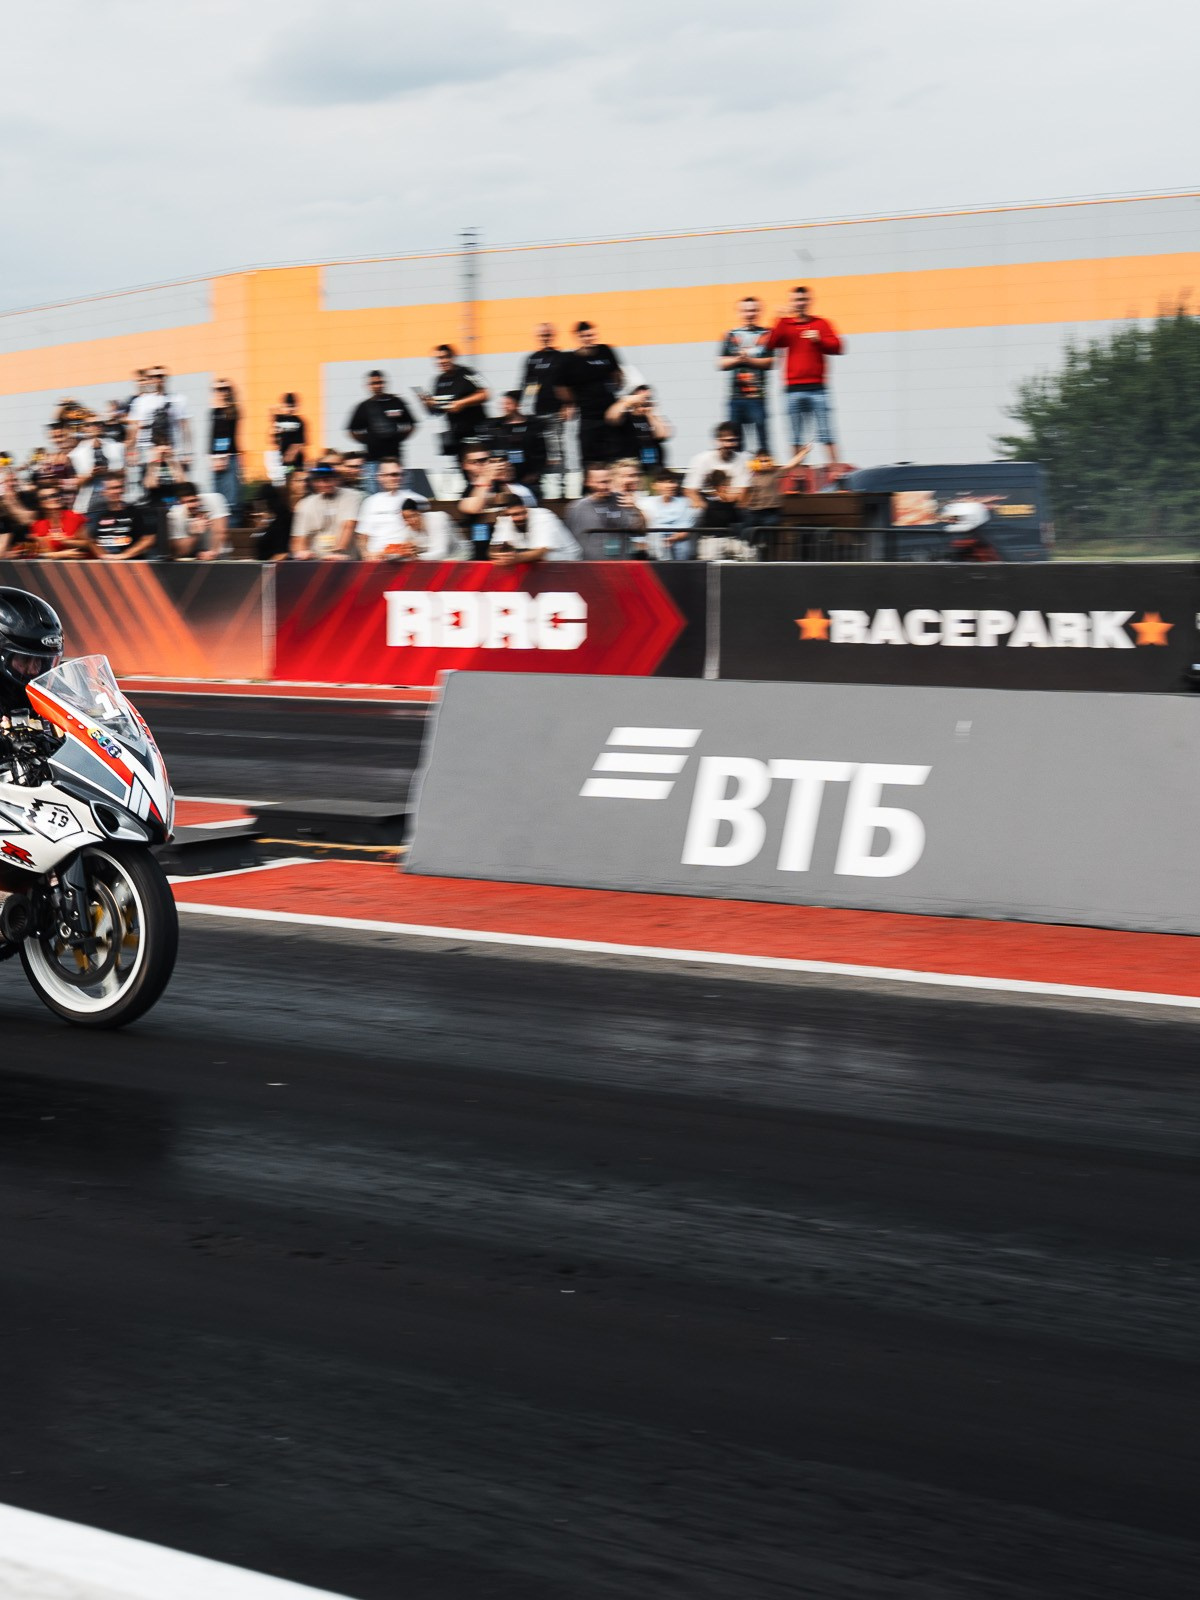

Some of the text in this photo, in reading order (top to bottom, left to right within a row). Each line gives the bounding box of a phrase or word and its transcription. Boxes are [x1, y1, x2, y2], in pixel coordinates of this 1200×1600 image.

[383, 591, 588, 650] RDRC
[828, 608, 1136, 649] RACEPARK
[47, 811, 70, 829] 19
[681, 756, 933, 877] ВТБ
